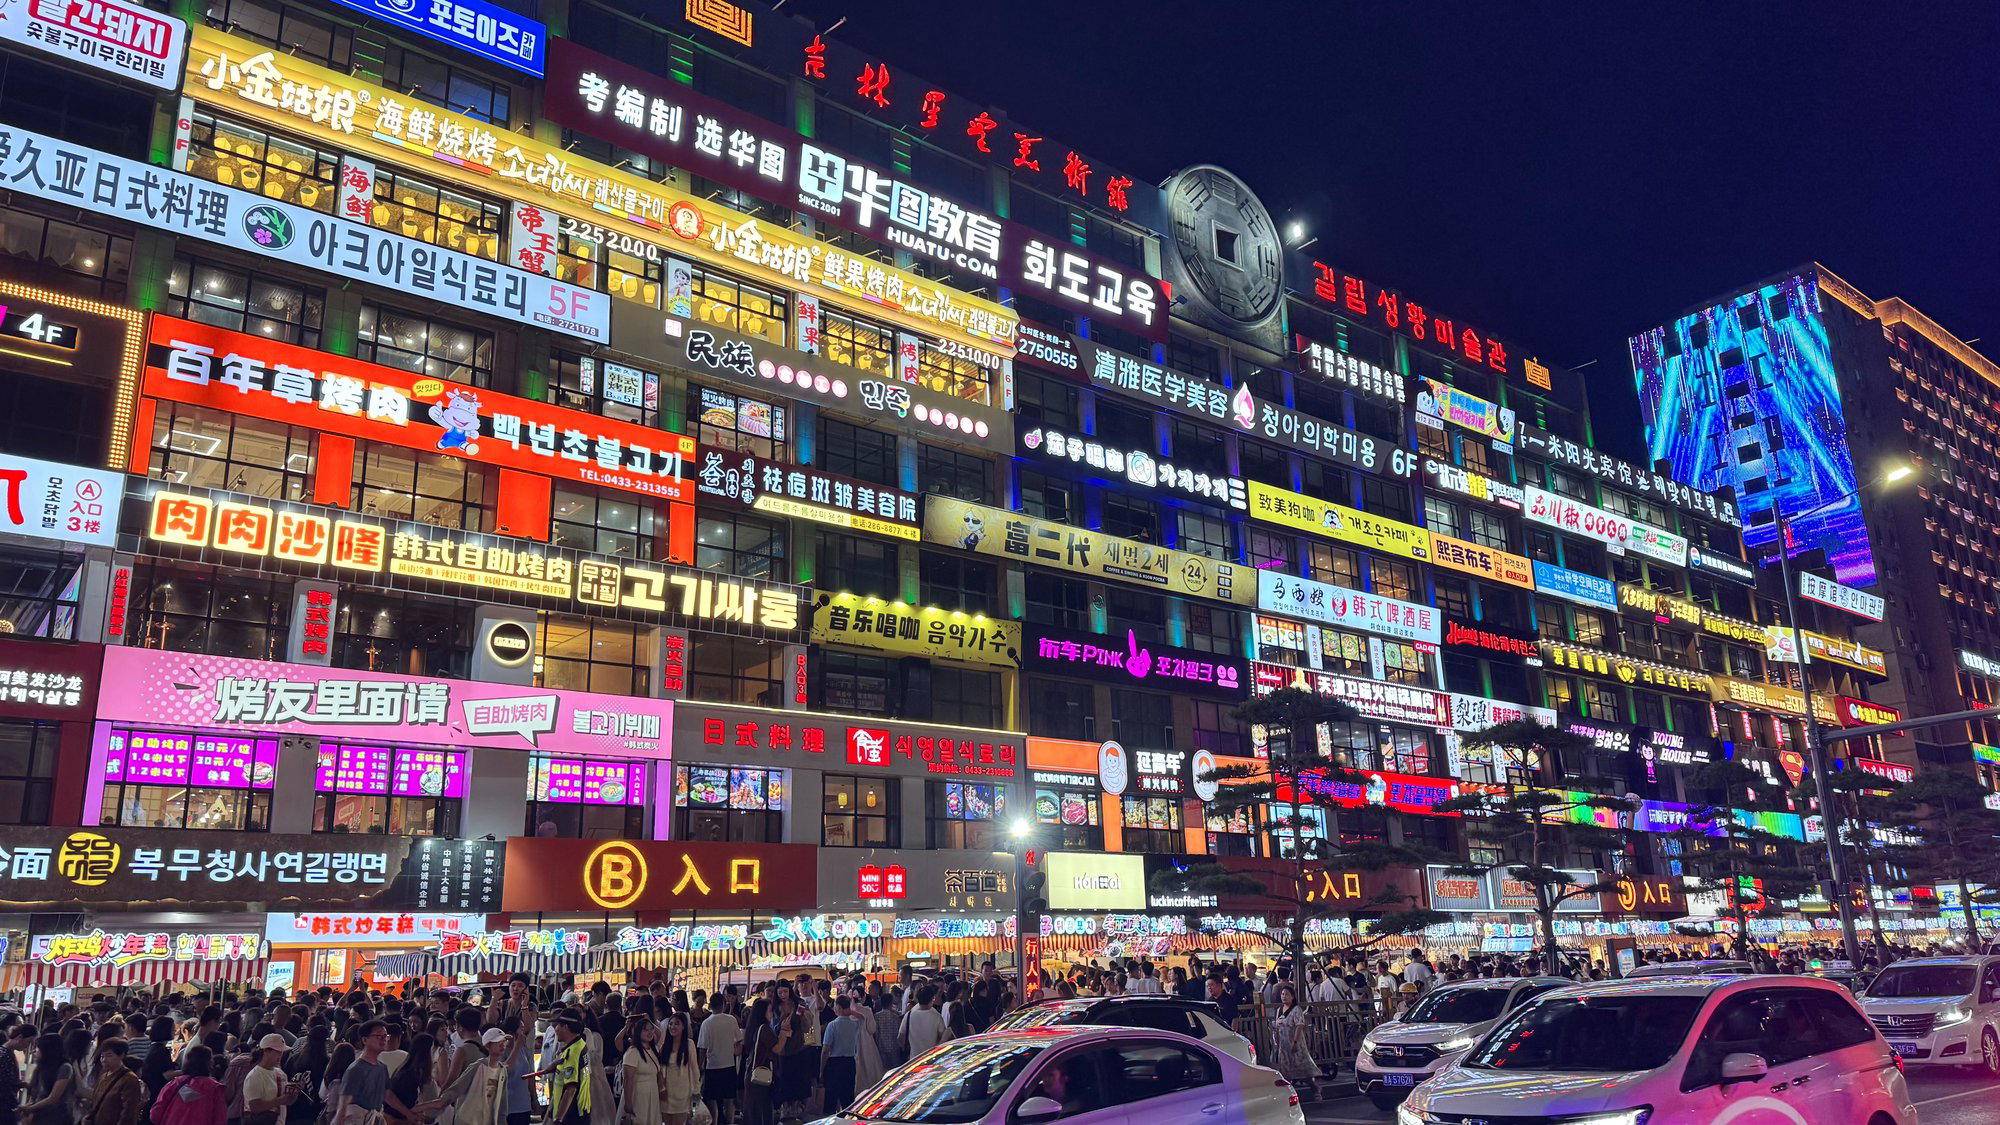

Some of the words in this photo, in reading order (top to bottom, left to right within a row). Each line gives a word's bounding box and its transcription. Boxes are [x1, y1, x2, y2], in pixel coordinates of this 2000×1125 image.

[202, 52, 357, 134] 小金姑娘
[579, 72, 683, 142] 考编制
[377, 96, 497, 166] 海鲜烧烤
[695, 113, 786, 182] 选华图
[342, 164, 373, 224] 海鲜
[594, 178, 665, 221] 해산물구이
[799, 193, 819, 211] SINCE
[820, 202, 841, 217] 2001
[515, 204, 557, 275] 帝王蟹
[565, 218, 662, 264] 2252000
[710, 220, 811, 283] 小金姑娘
[309, 219, 527, 316] 아크아일식료리
[824, 251, 904, 303] 鲜果烤肉
[1024, 239, 1155, 326] 화도교육
[550, 284, 591, 320] 5F
[798, 301, 819, 346] 鲜果
[18, 313, 63, 343] 4F
[688, 332, 756, 376] 民族
[900, 340, 920, 385] 烤肉
[938, 339, 1000, 370] 2251000
[1018, 339, 1078, 370] 2750555
[167, 340, 409, 427] 百年草烤肉
[1094, 347, 1229, 419] 清雅医学美容
[492, 413, 682, 484] 백년초불고기
[680, 440, 693, 451] 4F
[1261, 403, 1376, 468] 청아의학미용
[1392, 448, 1418, 478] 6F
[1529, 434, 1634, 485] 一米阳光宾馆
[70, 500, 102, 516] 入口
[763, 465, 916, 522] 祛痘斑皱美容院
[1259, 492, 1316, 524] 致美狗咖
[67, 517, 101, 534] 3楼
[154, 497, 384, 567] 肉肉沙隆
[1005, 520, 1091, 568] 富二代
[393, 533, 571, 584] 韩式自助烤肉
[1188, 564, 1201, 579] 24
[621, 566, 798, 630] 고기싸롱
[1353, 595, 1432, 632] 韩式啤酒屋
[829, 605, 921, 641] 音乐唱咖
[928, 620, 1008, 653] 음악가수
[473, 703, 548, 725] 自助烤肉
[703, 717, 825, 753] 日式料理
[1653, 731, 1684, 748] YOUNG
[1660, 747, 1691, 765] HOUSE
[128, 847, 387, 885] 복무청사연길랭면
[600, 854, 634, 899] B
[671, 853, 760, 896] 入口
[1320, 871, 1361, 899] 入口
[1643, 881, 1672, 904] 入口
[311, 916, 415, 935] 韩式炒年糕
